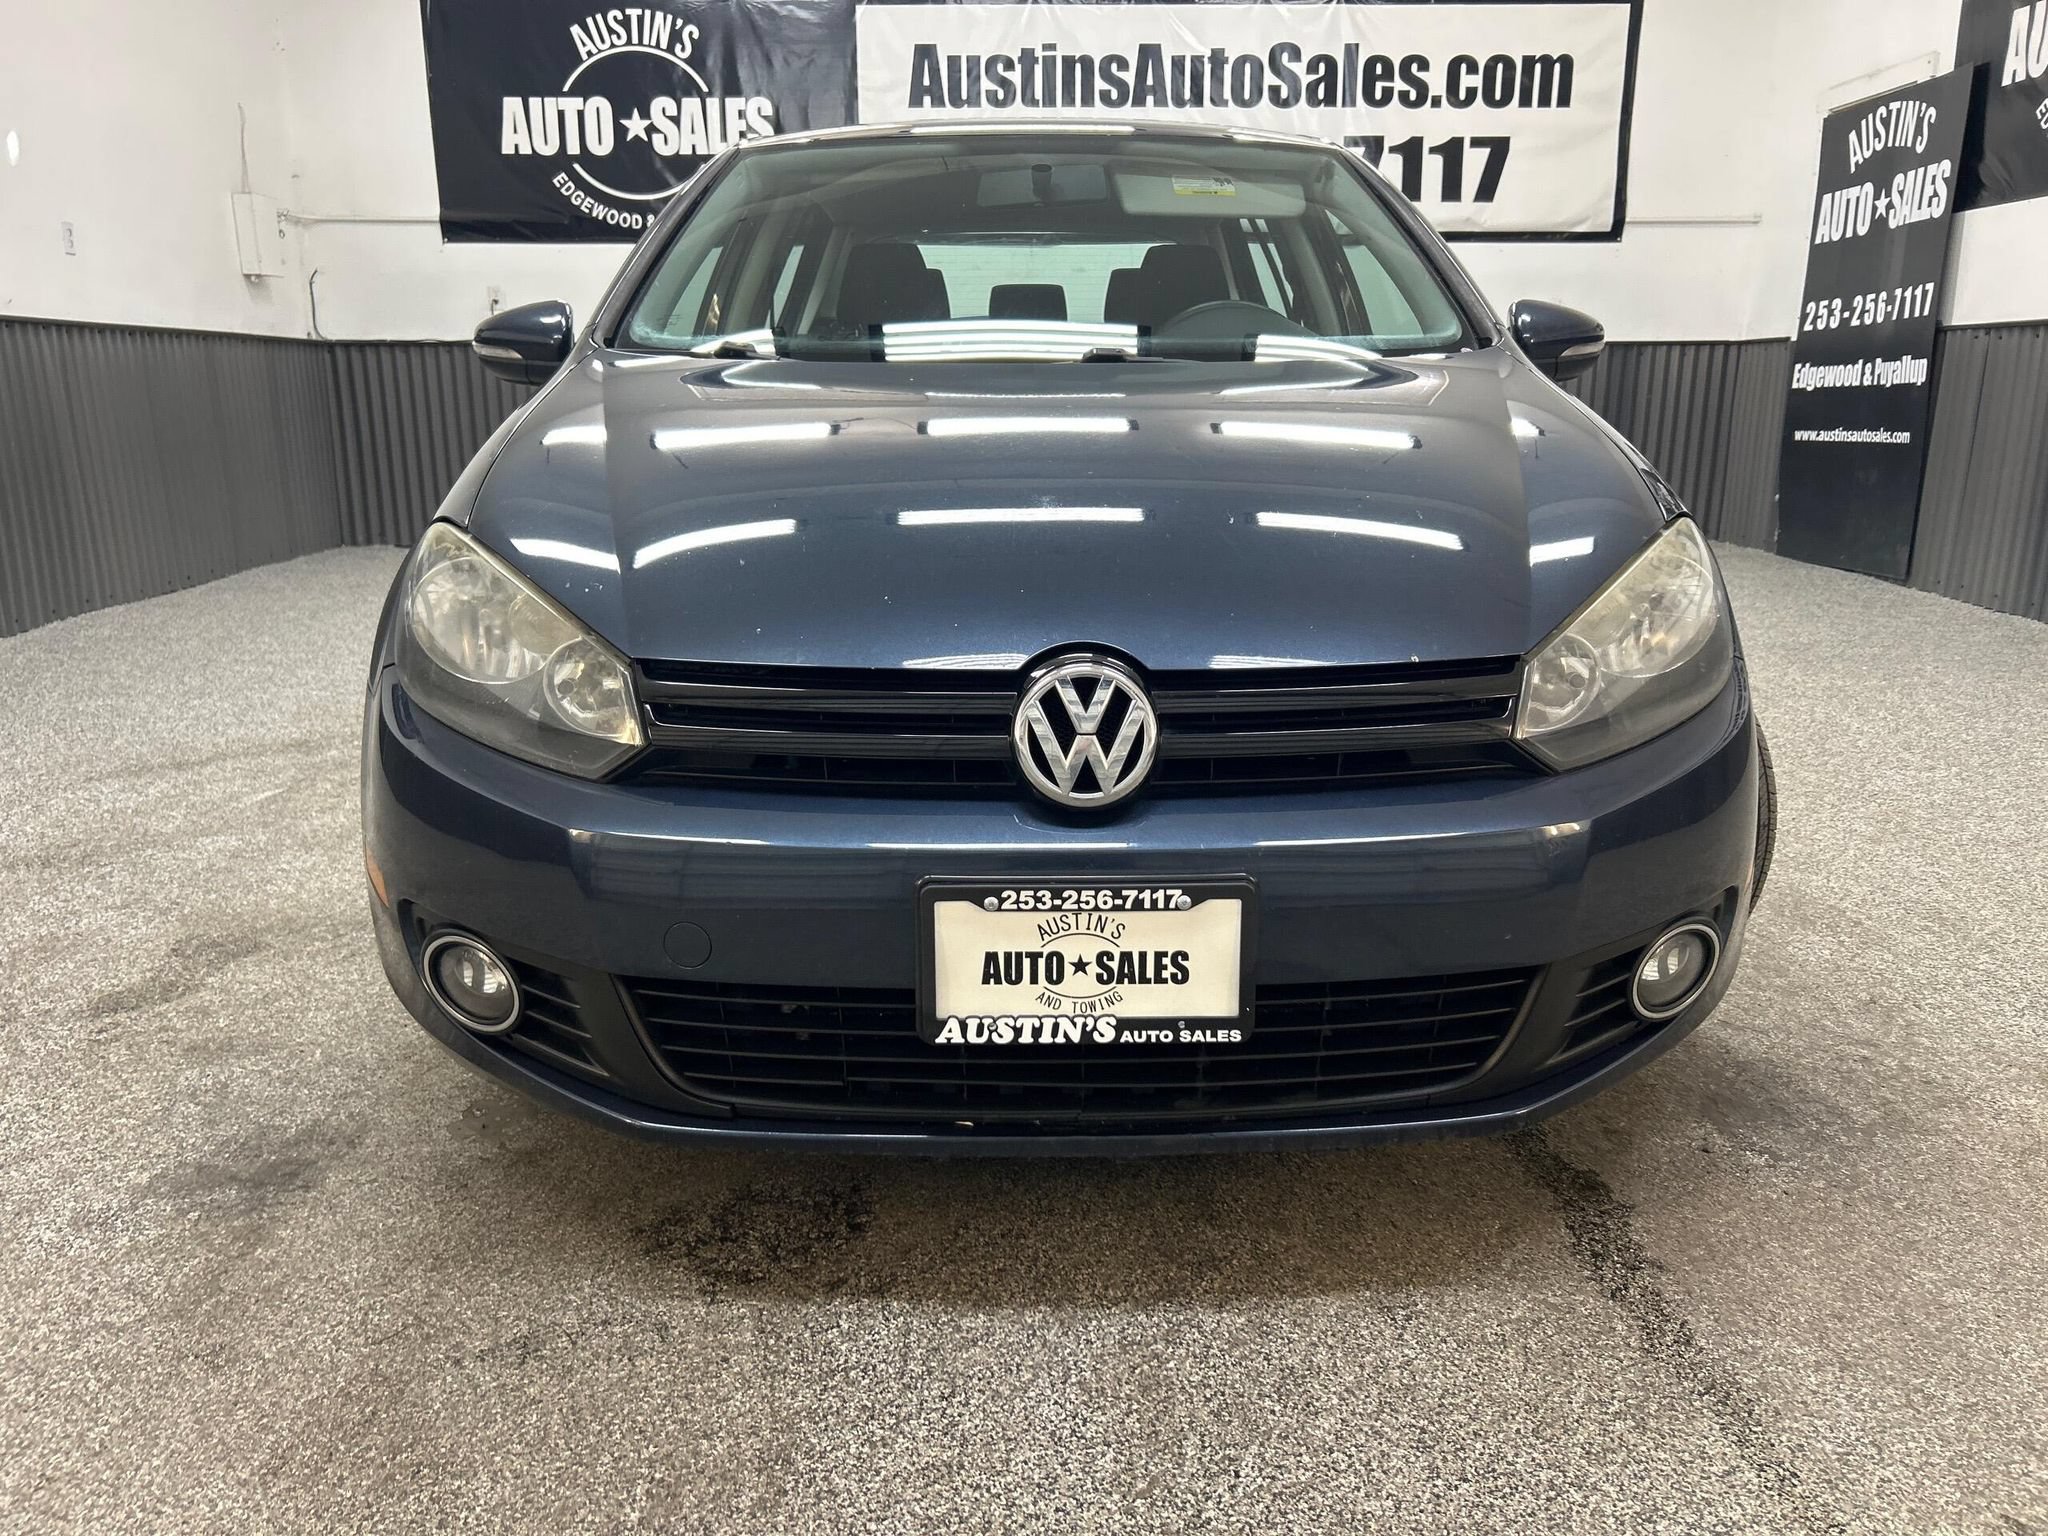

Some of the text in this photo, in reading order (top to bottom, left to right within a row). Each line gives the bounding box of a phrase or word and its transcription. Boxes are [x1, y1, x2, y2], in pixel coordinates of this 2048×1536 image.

[569, 8, 700, 62] AUSTIN'S
[908, 42, 1574, 110] AustinsAutoSales.com
[501, 96, 776, 157] AUTO SALES
[1848, 100, 1937, 175] AUSTIN'S
[552, 171, 643, 231] EDGEWOOD
[1814, 159, 1952, 245] AUTO SALES
[1803, 282, 1935, 331] 253-256-7117
[1791, 355, 1928, 391] Edgewood & Puyallup
[1794, 427, 1911, 445] www.austinsautosales.com
[1000, 889, 1182, 910] 253-256-7117
[1036, 912, 1126, 942] AUSTIN'S
[981, 950, 1190, 986] AUTO SALES
[1035, 990, 1124, 1015] AND TOWING
[934, 1014, 1242, 1045] AUSTIN'S AUTO SALES
